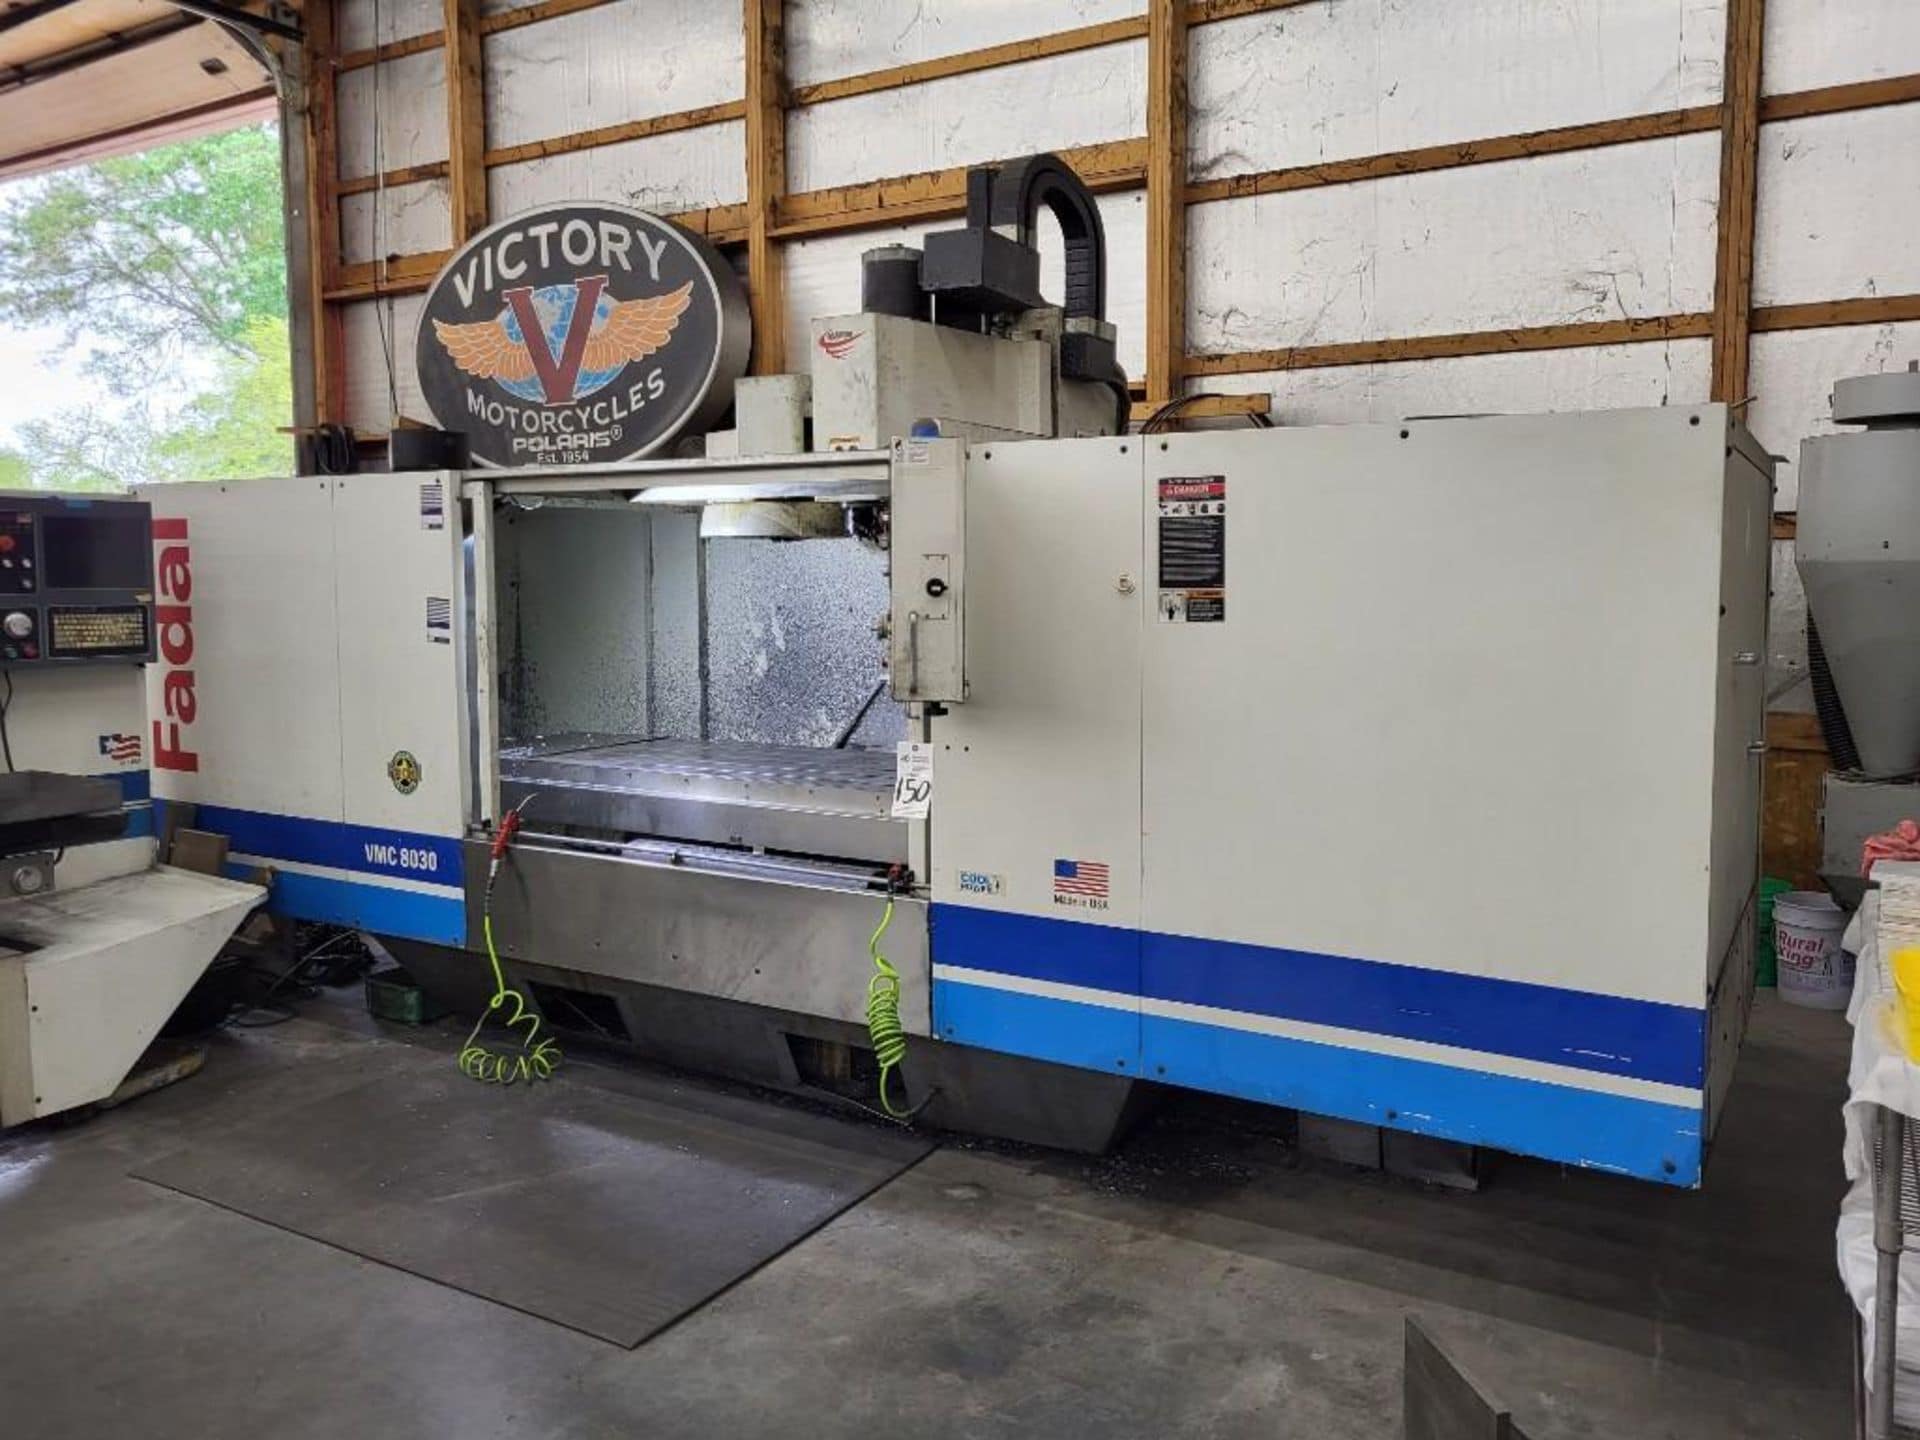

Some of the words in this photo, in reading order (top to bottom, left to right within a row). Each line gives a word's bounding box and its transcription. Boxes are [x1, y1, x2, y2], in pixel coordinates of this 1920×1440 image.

[453, 219, 667, 308] VICTORY
[467, 367, 666, 434] MOTORCYCLES
[152, 518, 198, 773] Fadal
[896, 776, 931, 804] 150
[364, 843, 397, 866] VMC
[400, 847, 438, 871] 8030
[1779, 930, 1825, 952] Rural
